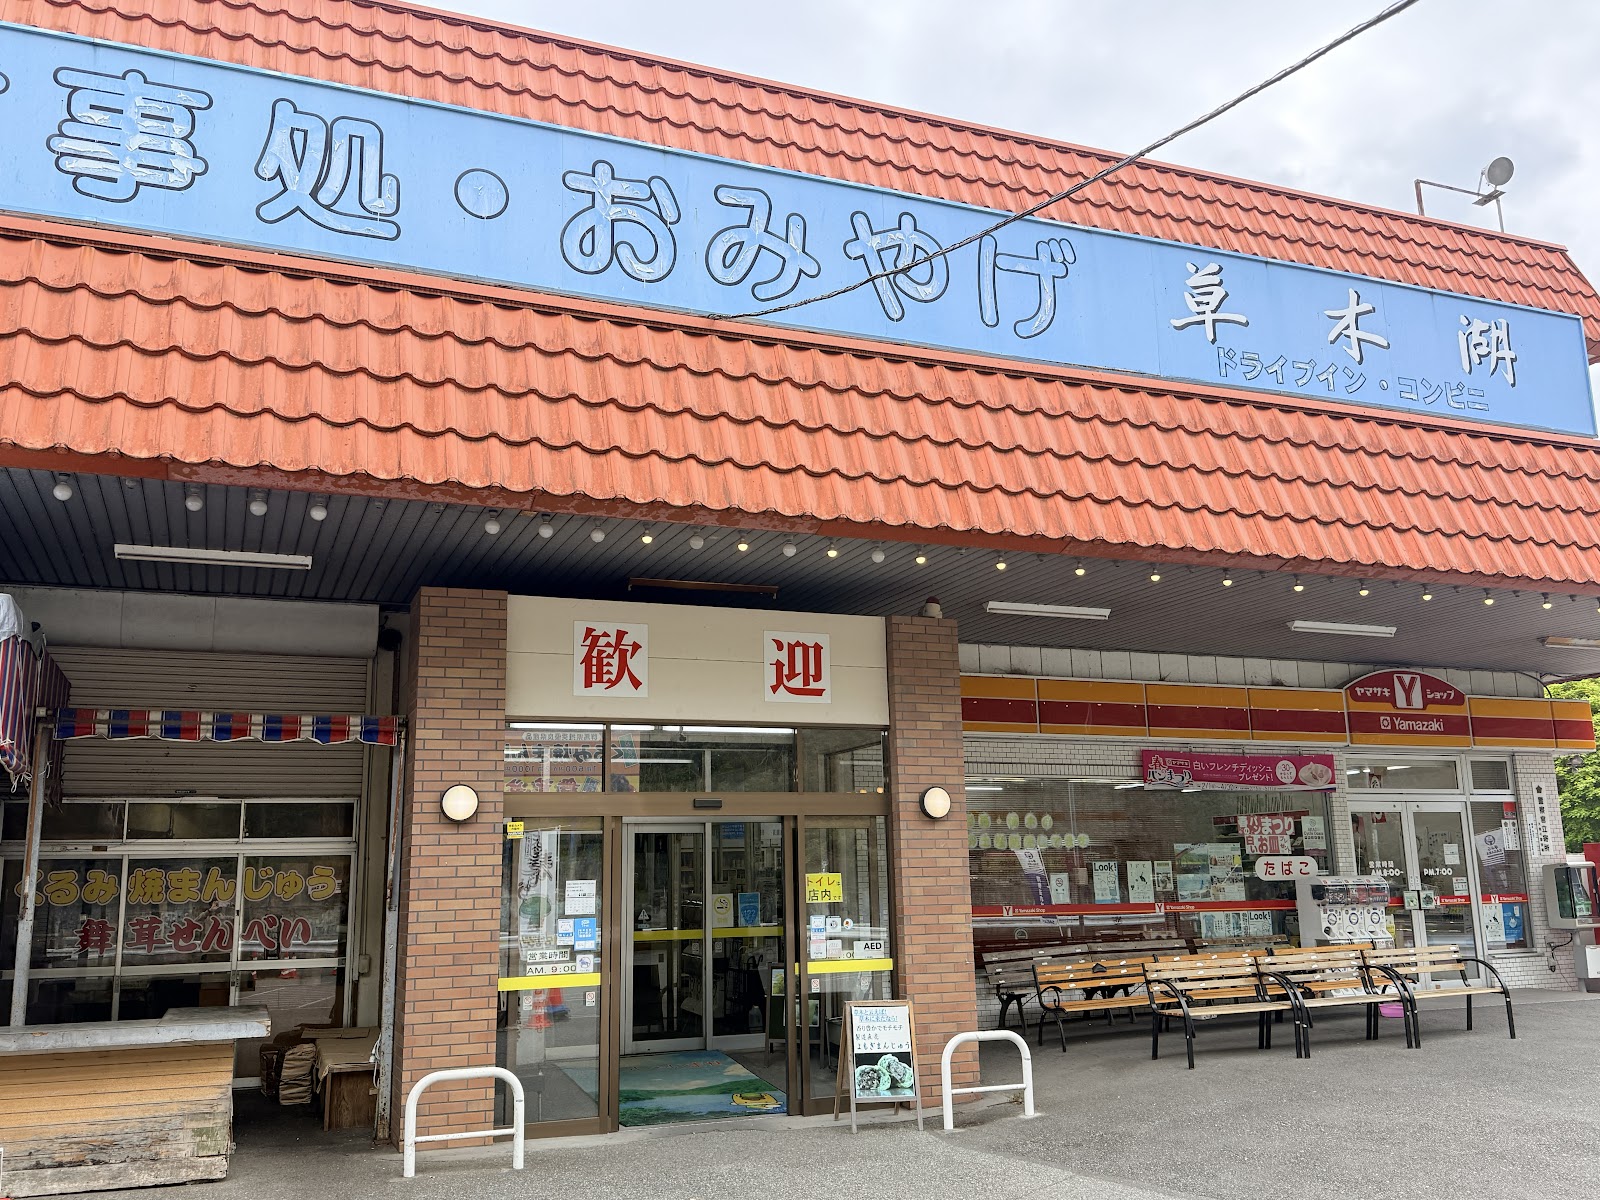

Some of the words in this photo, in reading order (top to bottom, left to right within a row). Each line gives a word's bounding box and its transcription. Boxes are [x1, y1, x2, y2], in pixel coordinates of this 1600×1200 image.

[1170, 262, 1518, 388] 草木湖
[1217, 346, 1490, 412] ドライブイン・コンビニ
[1425, 688, 1455, 700] ショップ
[1393, 716, 1444, 732] Yamazaki
[1193, 761, 1273, 773] 白いフレンチディッシュ
[1147, 769, 1193, 783] パンまつり
[1093, 862, 1118, 872] Look!
[1264, 860, 1310, 876] たばこ
[1249, 911, 1271, 921] Look!
[73, 914, 312, 956] 舞茸せんべい
[863, 942, 882, 950] AED
[527, 950, 569, 961] 営業時間
[551, 964, 577, 974] 9:00
